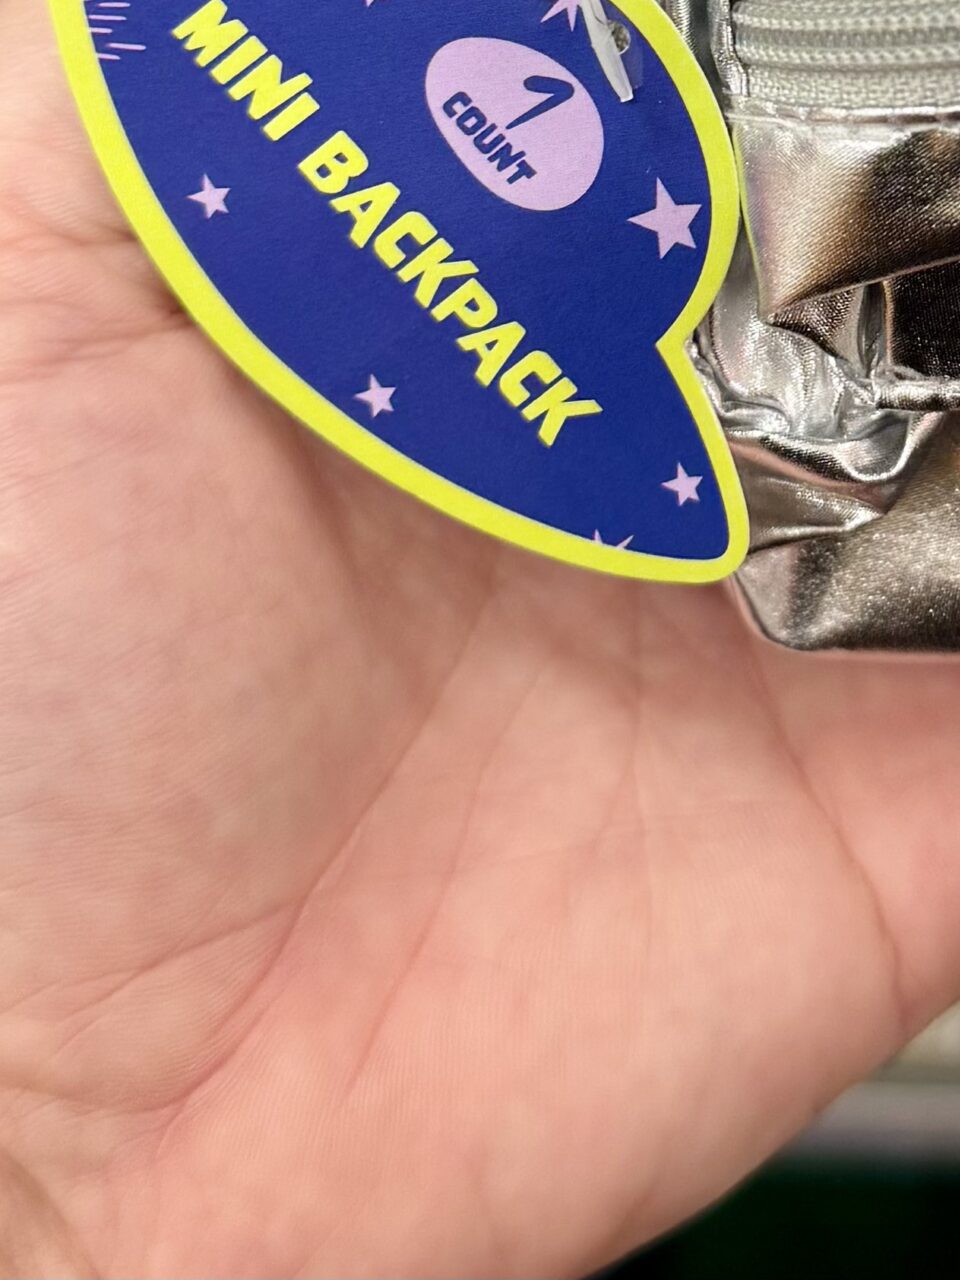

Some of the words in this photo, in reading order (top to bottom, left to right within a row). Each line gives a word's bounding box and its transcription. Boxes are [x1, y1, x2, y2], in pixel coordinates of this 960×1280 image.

[442, 92, 537, 185] COUNT
[505, 76, 575, 128] 1
[298, 131, 602, 447] BACKPACK
